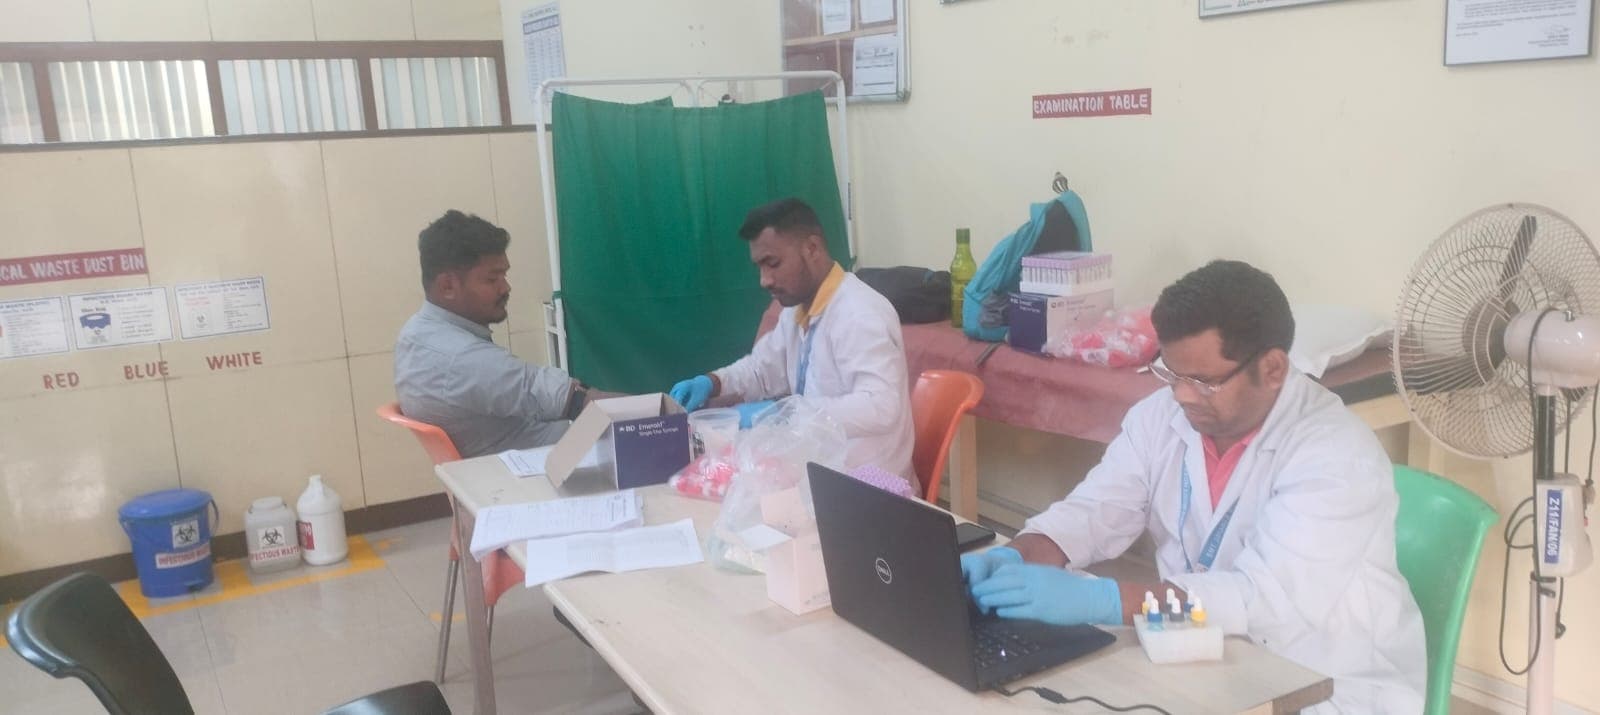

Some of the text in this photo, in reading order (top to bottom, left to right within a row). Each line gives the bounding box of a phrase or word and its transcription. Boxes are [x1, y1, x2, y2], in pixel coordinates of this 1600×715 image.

[1033, 94, 1148, 114] EXAMINATION TABLE
[0, 254, 145, 281] CAL WASTE DUST BIN
[124, 361, 169, 380] BLUE
[206, 352, 262, 370] WHITE
[43, 372, 79, 390] RED
